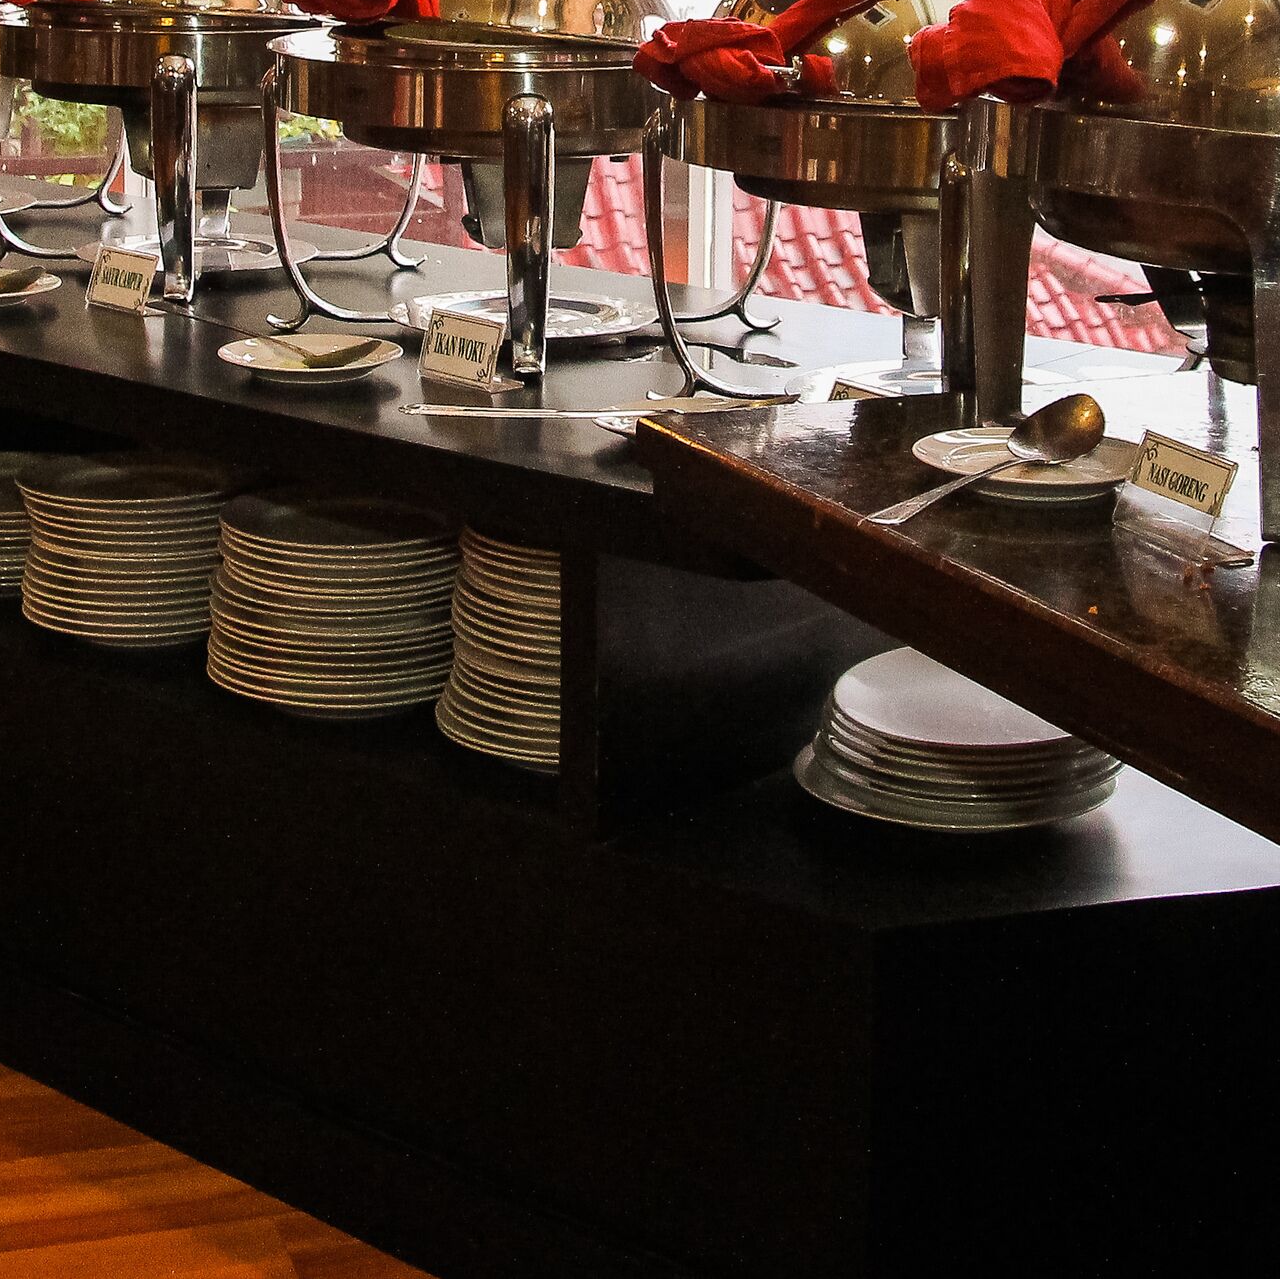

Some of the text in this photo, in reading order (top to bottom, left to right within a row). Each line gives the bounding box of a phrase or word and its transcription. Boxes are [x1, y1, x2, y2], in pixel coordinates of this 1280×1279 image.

[433, 332, 487, 364] IKAN WOKU
[1147, 462, 1210, 502] NASI GORENG
